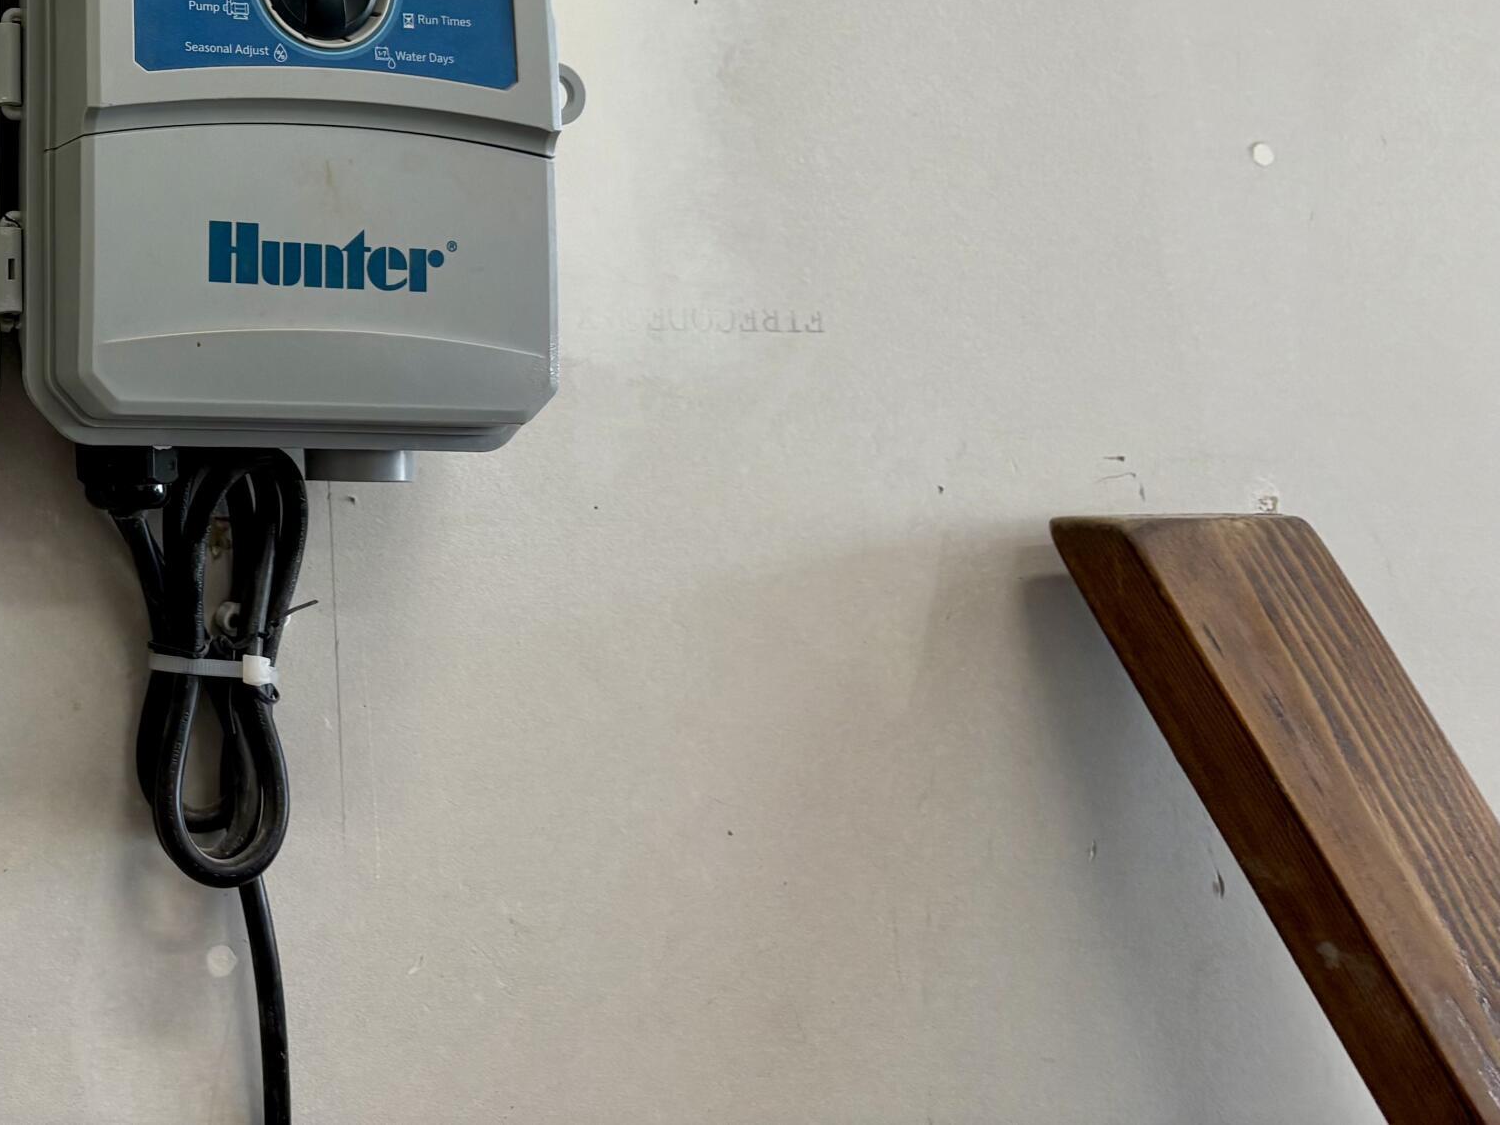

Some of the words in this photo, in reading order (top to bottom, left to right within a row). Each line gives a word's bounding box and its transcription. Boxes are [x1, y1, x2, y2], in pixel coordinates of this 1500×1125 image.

[188, 0, 219, 14] Pump
[418, 15, 438, 25] Run
[440, 15, 472, 27] Times
[184, 41, 232, 54] Seasonal
[235, 44, 269, 57] Adjust
[395, 51, 426, 62] Water
[429, 53, 454, 65] Days
